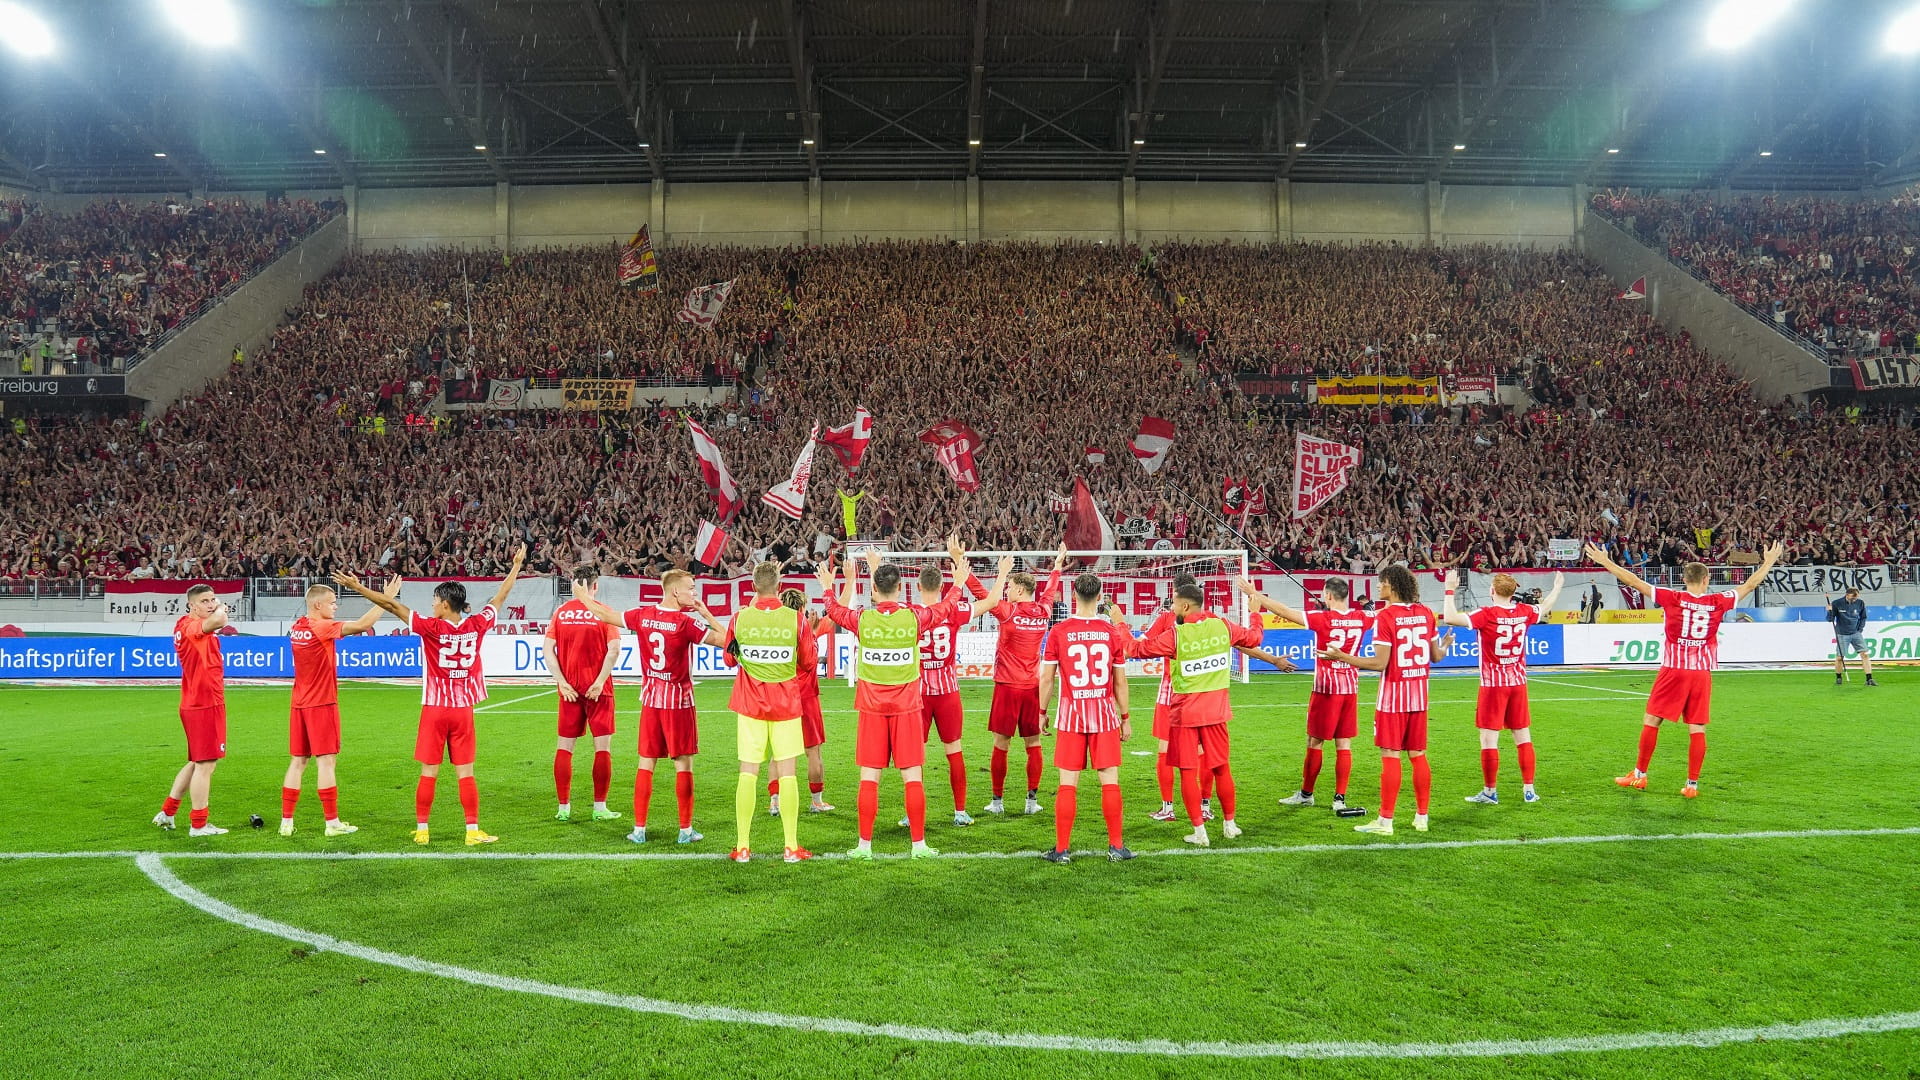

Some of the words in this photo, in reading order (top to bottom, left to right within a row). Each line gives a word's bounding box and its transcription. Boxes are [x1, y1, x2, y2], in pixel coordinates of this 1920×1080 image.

[565, 381, 632, 390] #BOYCOTT
[565, 389, 628, 403] QATAR
[1829, 568, 1883, 592] BURG
[109, 601, 158, 614] Fanclub
[641, 618, 650, 628] SC
[863, 626, 916, 639] CAZOO
[1681, 608, 1710, 639] 18
[741, 627, 792, 640] CAZOO
[918, 625, 951, 660] 28
[1067, 632, 1077, 642] SC
[1077, 631, 1110, 642] FREIBURG
[1181, 634, 1228, 653] CAZOO
[1329, 628, 1362, 657] 27
[1494, 622, 1527, 656] 23
[438, 639, 477, 668] 29
[648, 631, 666, 671] 3
[743, 648, 790, 659] CAZOO
[864, 651, 911, 662] CAZOO
[1396, 626, 1430, 668] 25
[1609, 640, 1660, 662] JOB
[0, 648, 116, 671] haftsprüfer
[1067, 643, 1110, 688] 33
[1184, 657, 1227, 672] CAZOO
